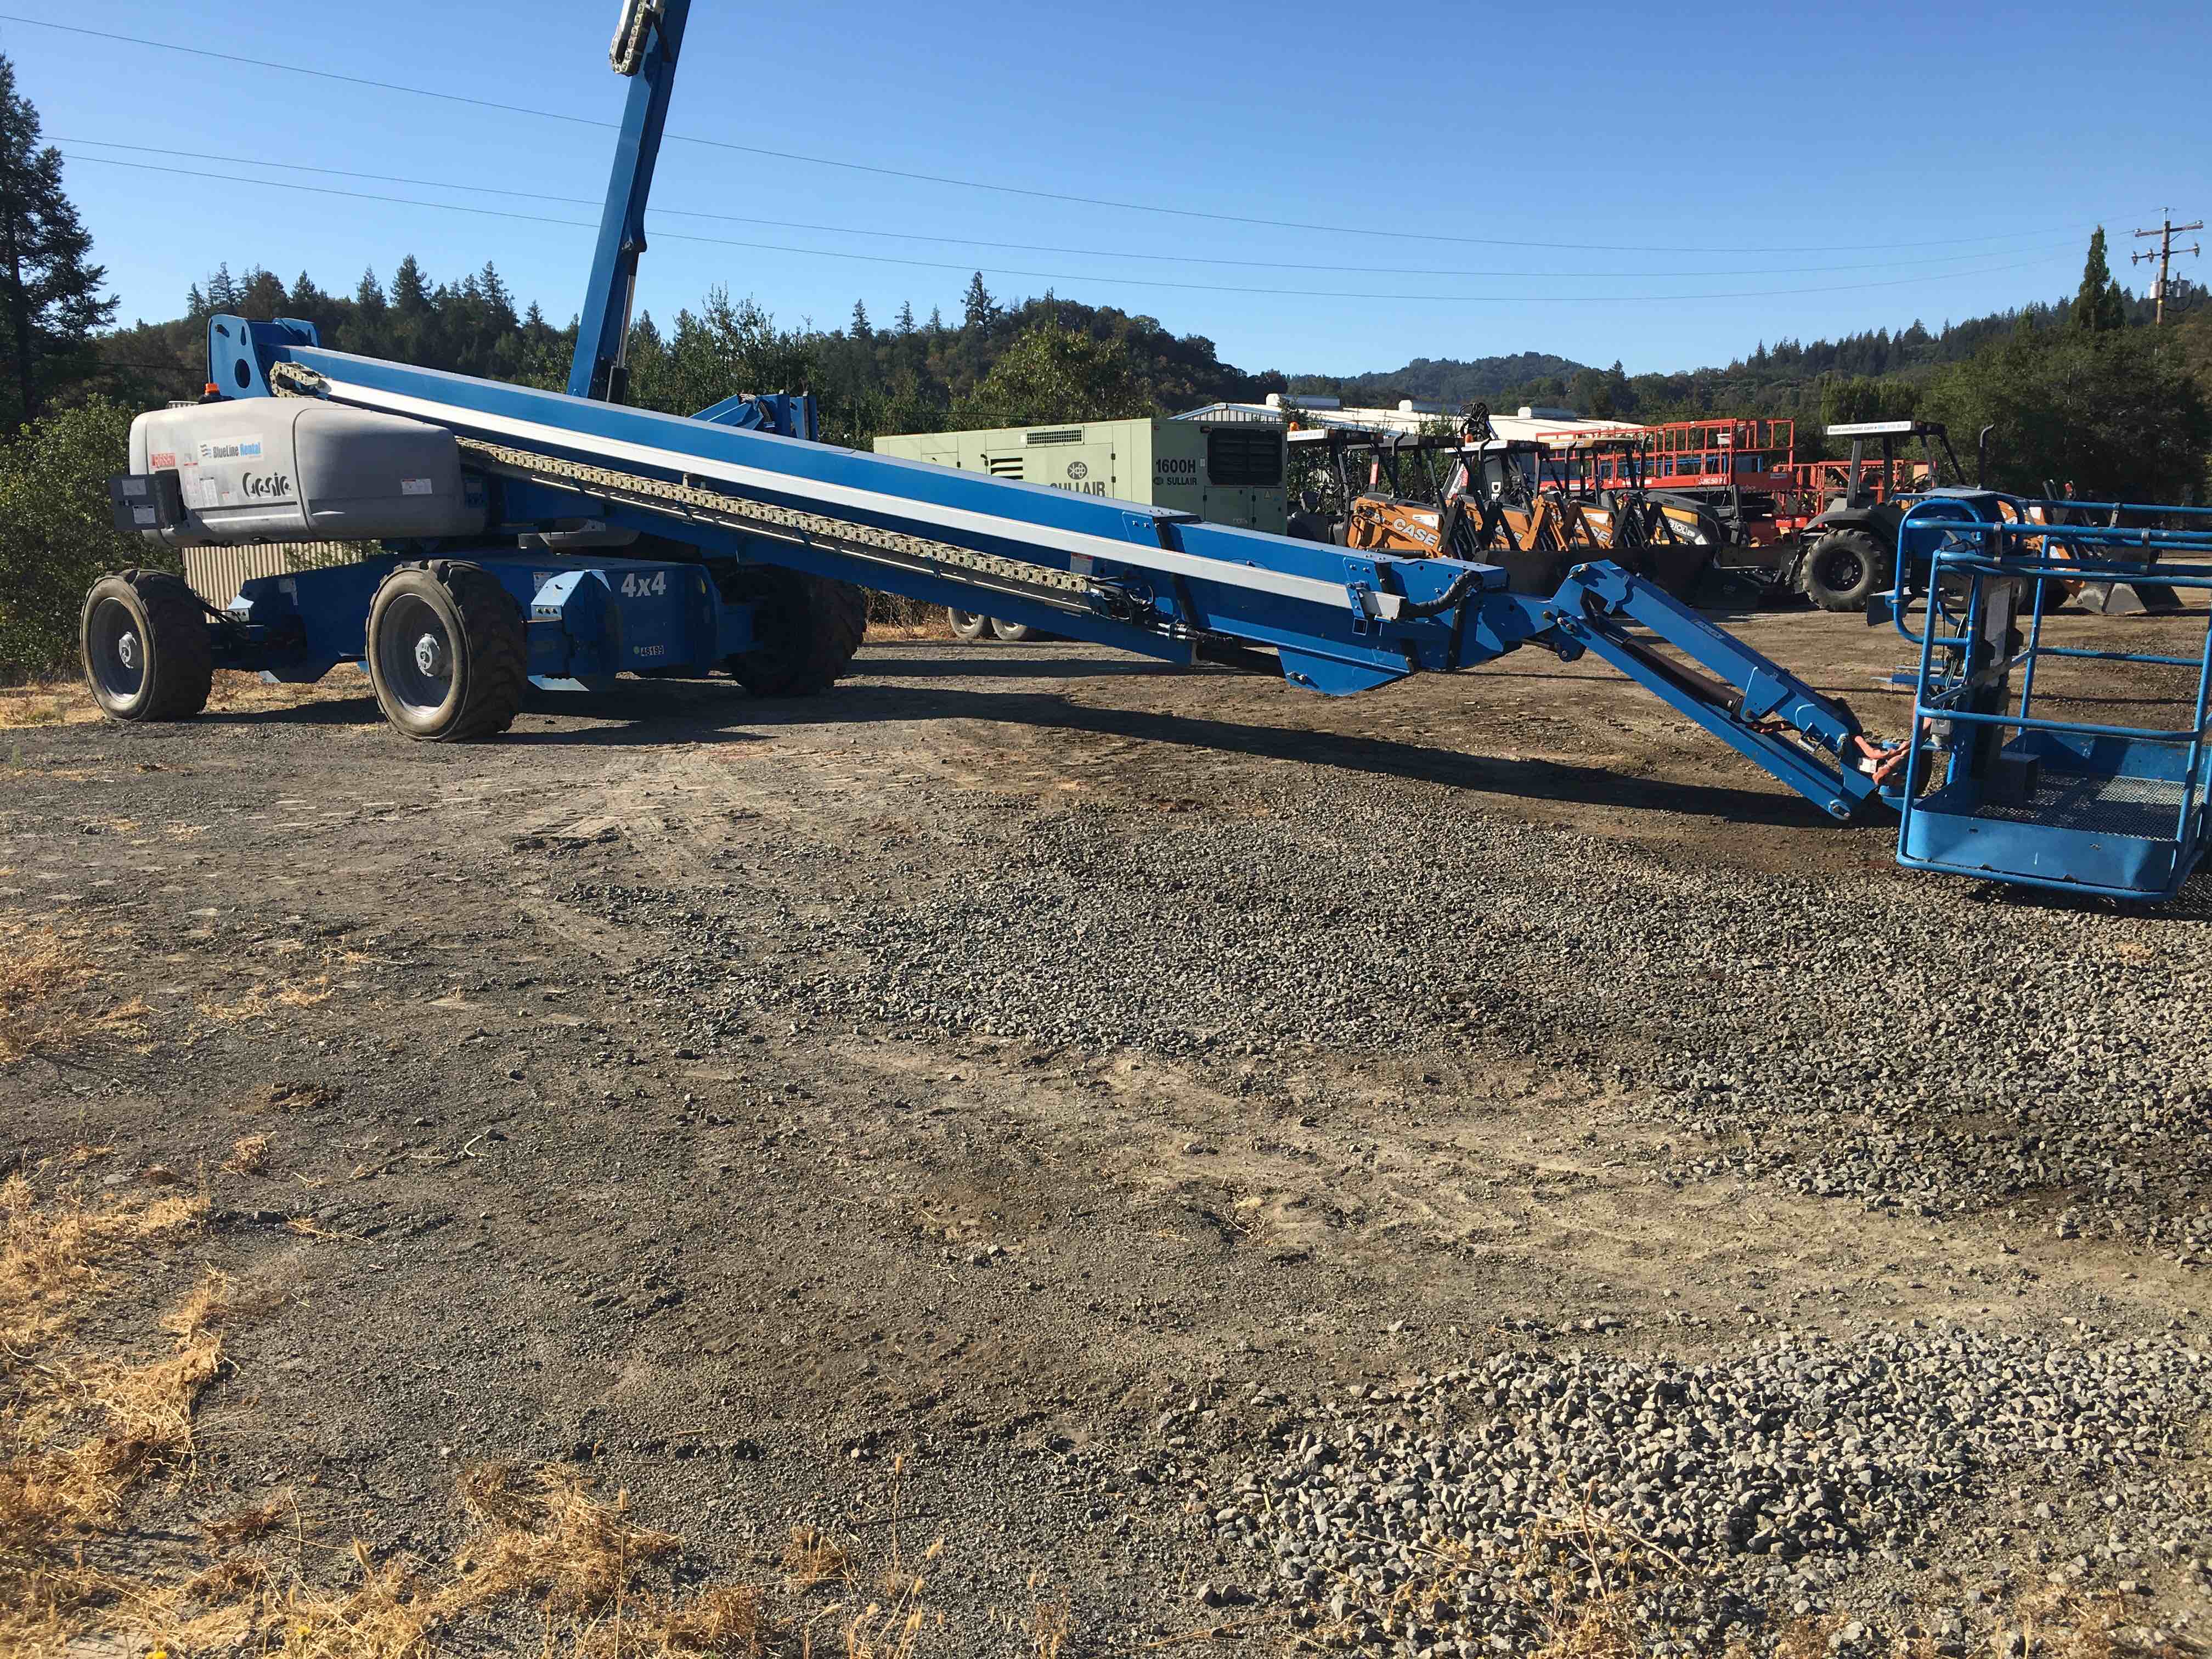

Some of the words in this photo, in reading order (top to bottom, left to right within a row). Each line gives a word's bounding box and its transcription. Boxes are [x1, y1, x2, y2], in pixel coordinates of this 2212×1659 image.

[213, 445, 239, 459] BlueLine
[240, 442, 261, 456] Rental
[1155, 459, 1196, 473] 1600H
[242, 472, 292, 497] Genie
[1167, 477, 1197, 486] SULLAIR
[1393, 517, 1438, 548] CASE
[620, 571, 667, 597] 4x4
